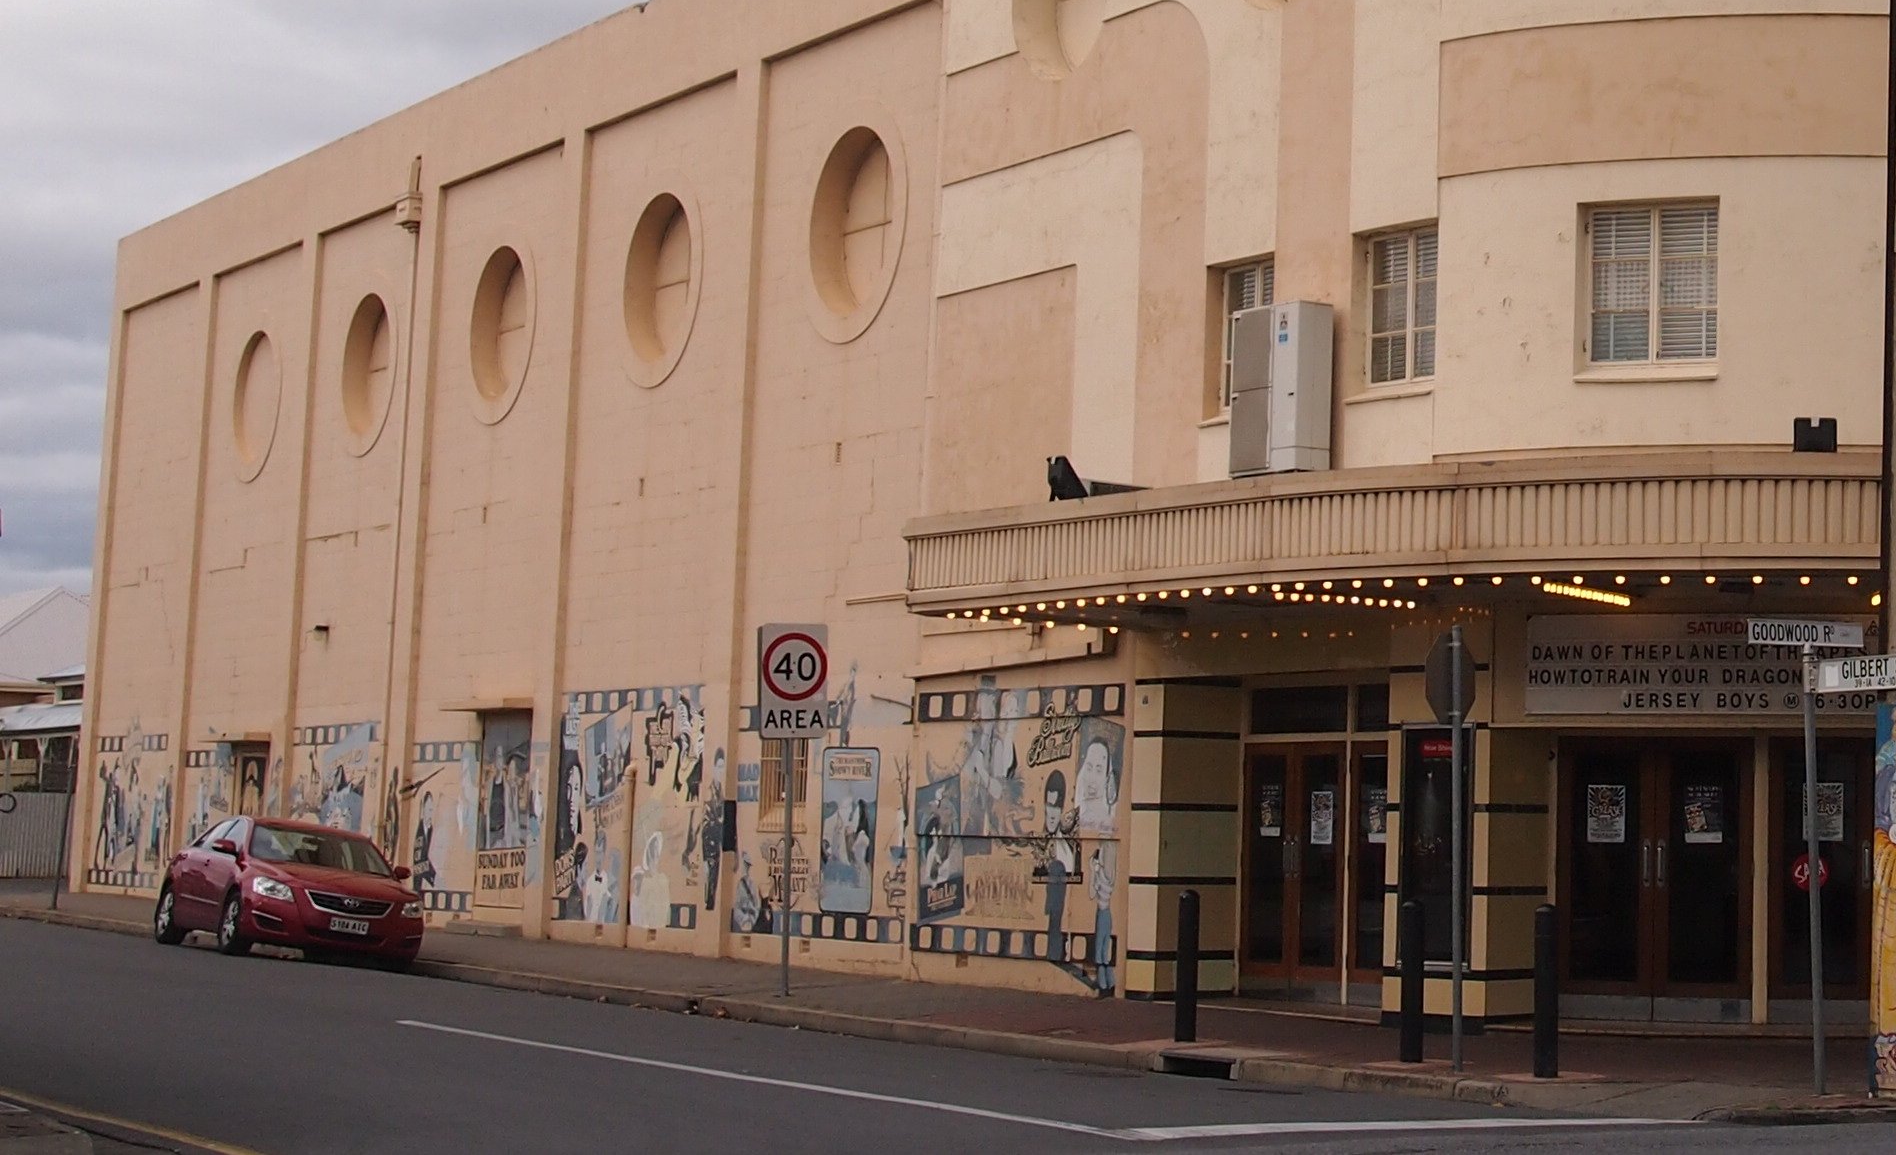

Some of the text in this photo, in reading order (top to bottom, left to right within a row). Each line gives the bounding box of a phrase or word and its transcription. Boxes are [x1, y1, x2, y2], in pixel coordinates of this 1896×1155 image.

[1687, 621, 1748, 635] SATURD
[1752, 623, 1819, 643] GOODWOOD
[1532, 645, 1583, 661] DAWN
[1591, 645, 1614, 661] OF
[773, 652, 817, 682] 40
[1842, 658, 1889, 680] GILBERT
[1658, 668, 1709, 684] YOUR
[1722, 668, 1803, 685] DRAGON
[1623, 693, 1700, 709] JERSEY
[1716, 693, 1769, 709] BOYS
[764, 709, 824, 729] AREA
[478, 850, 526, 869] SUNDAY TOO
[482, 872, 520, 890] FAR AWAY
